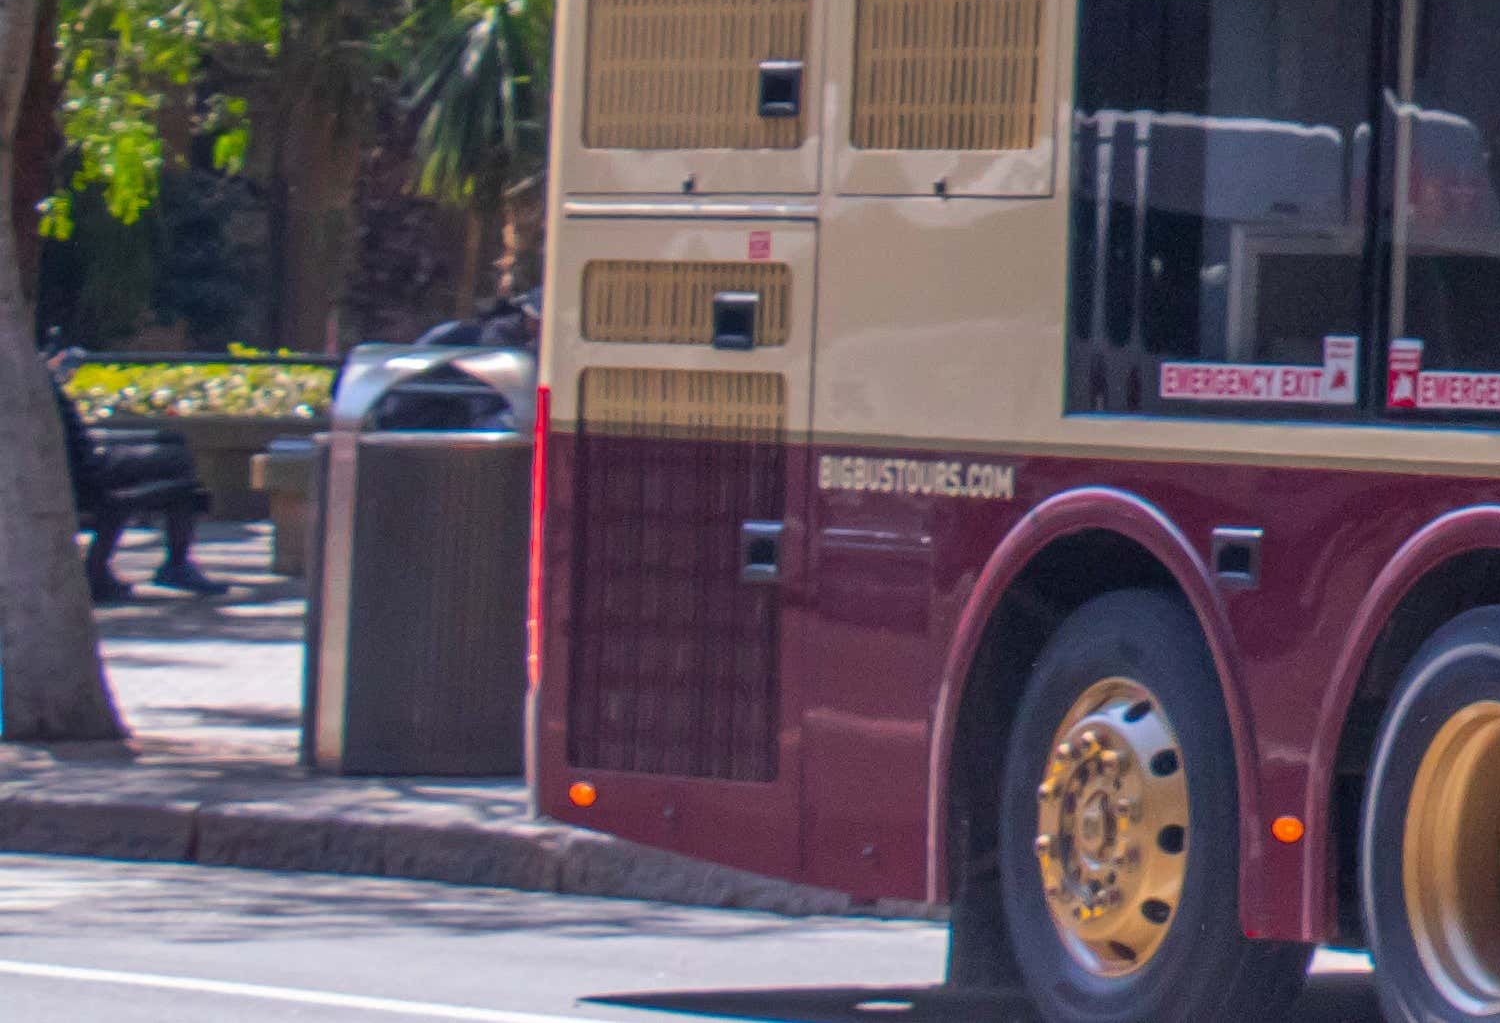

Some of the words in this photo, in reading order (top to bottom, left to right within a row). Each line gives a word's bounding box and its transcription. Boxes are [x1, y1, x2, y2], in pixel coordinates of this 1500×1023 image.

[1166, 367, 1275, 396] EMERGENCY
[1282, 369, 1322, 397] EXIT
[818, 455, 1015, 500] BIGBUSTOURS.COM
